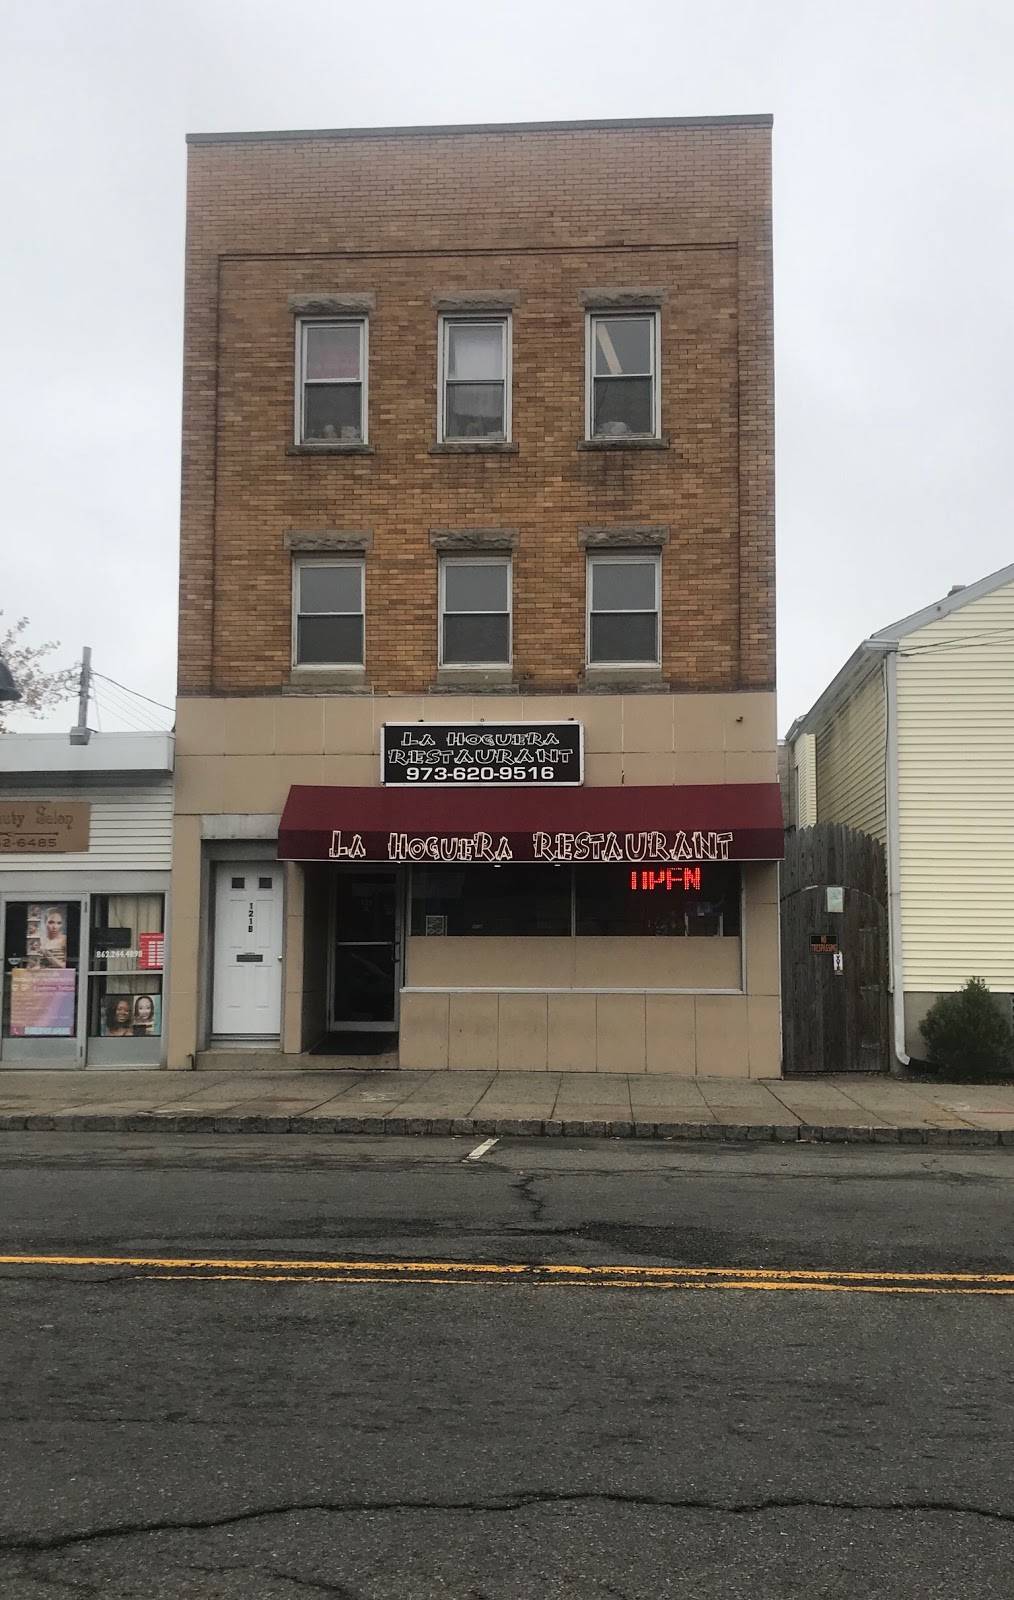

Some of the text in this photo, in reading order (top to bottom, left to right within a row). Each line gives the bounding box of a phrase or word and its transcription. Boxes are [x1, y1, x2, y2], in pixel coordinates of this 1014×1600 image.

[388, 748, 574, 765] RESTAURANT
[406, 766, 555, 780] 973-620-9516
[0, 811, 25, 828] uty
[0, 838, 57, 848] 2-6485
[533, 830, 734, 862] RESTAURANT
